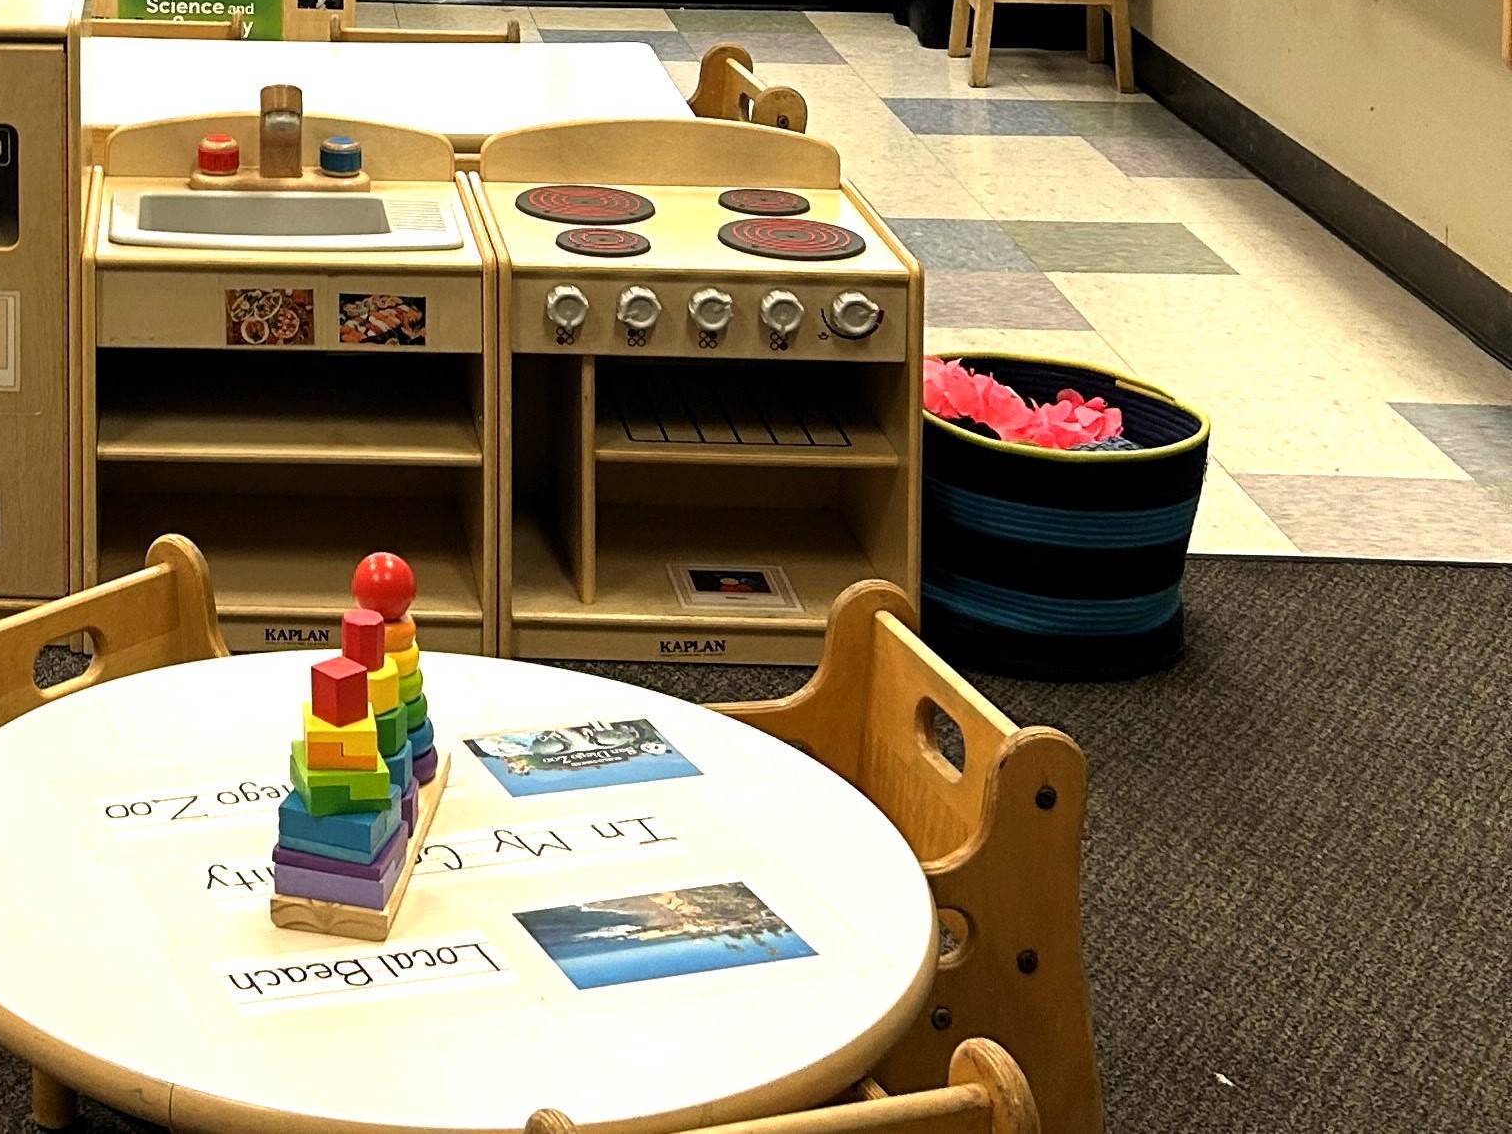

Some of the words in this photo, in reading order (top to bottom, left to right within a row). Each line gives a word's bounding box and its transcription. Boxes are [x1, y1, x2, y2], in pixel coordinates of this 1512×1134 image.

[227, 2, 255, 15] and
[265, 628, 330, 642] KAPLAN
[659, 640, 727, 653] KAPLAN
[105, 795, 210, 821] Zoo
[492, 829, 573, 857] My
[590, 816, 678, 845] In
[378, 943, 501, 979] Local
[228, 958, 374, 996] Beach
